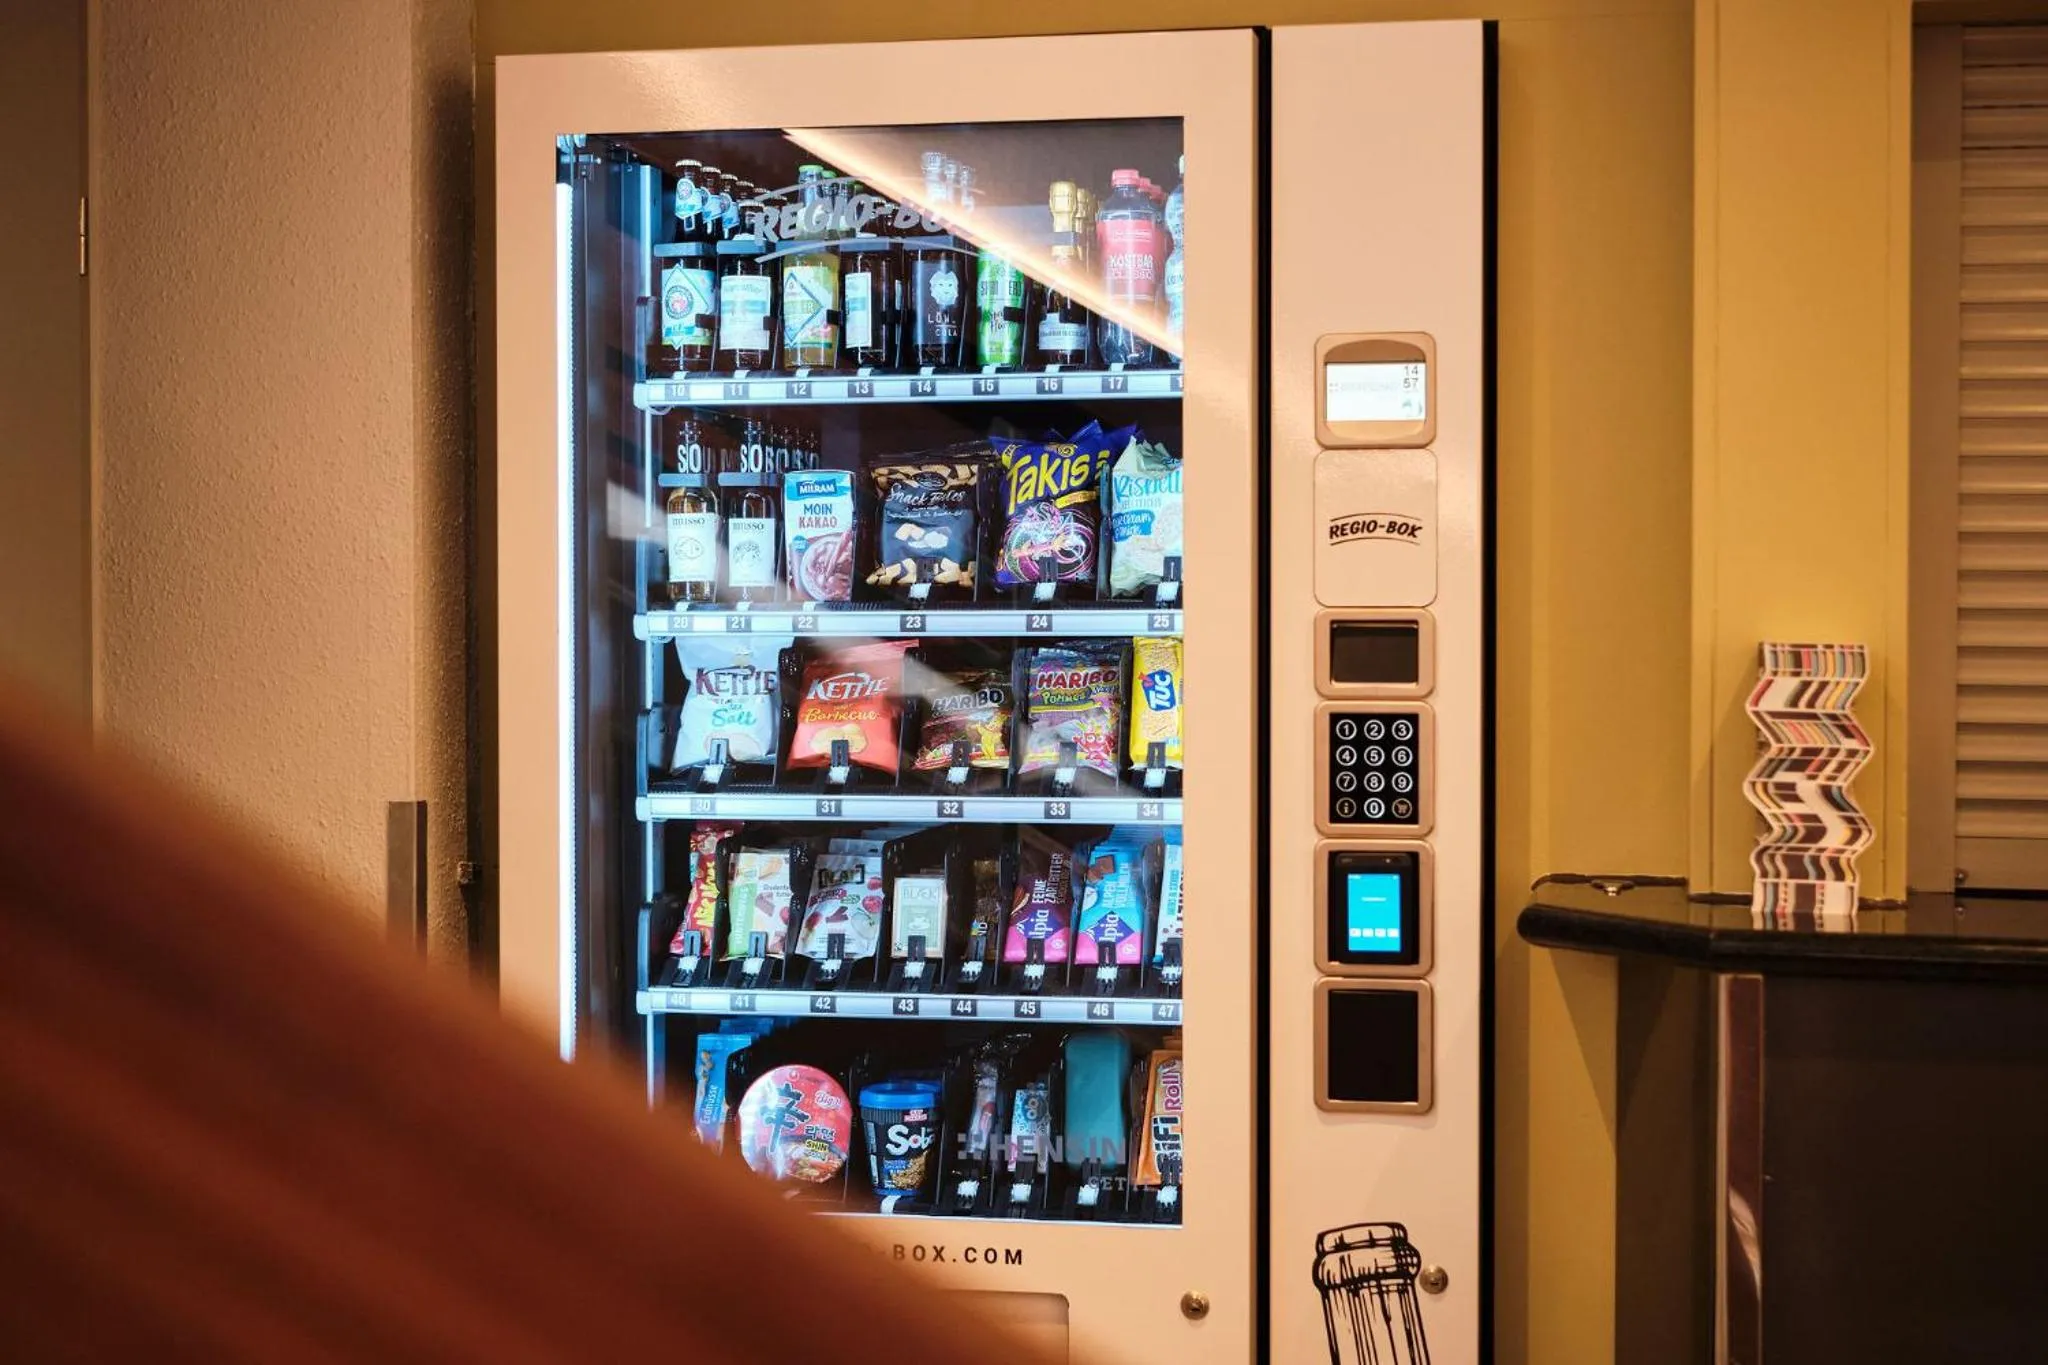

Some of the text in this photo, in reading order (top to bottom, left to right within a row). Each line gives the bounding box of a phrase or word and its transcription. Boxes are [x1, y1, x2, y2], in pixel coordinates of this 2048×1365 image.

[792, 383, 806, 395] 12
[855, 382, 869, 394] 13
[917, 381, 931, 392] 14
[979, 380, 994, 391] 15
[1042, 379, 1058, 391] 16
[1108, 378, 1123, 389] 17
[1177, 377, 1183, 389] 1
[671, 385, 685, 397] 10
[730, 384, 743, 396] 11
[799, 483, 835, 494] MILRAM
[1007, 453, 1090, 515] Takis
[886, 482, 928, 506] Snack
[803, 503, 833, 515] MOIN
[799, 516, 838, 529] KAKAO
[1329, 520, 1423, 539] REGIO-BOX
[674, 616, 688, 628] 20
[731, 616, 745, 628] 21
[798, 615, 813, 627] 22
[906, 616, 922, 628] 23
[1032, 616, 1048, 628] 24
[1153, 616, 1169, 628] 25
[1036, 668, 1118, 690] HARIBO
[806, 672, 890, 701] KETTLE
[1149, 674, 1172, 709] TUC
[932, 687, 1005, 713] HARIBO
[712, 707, 757, 727] Salt
[805, 707, 878, 723] Barbecue
[1343, 724, 1350, 736] 1
[1369, 724, 1379, 736] 2
[1397, 724, 1407, 736] 3
[1341, 750, 1351, 762] 4
[1370, 750, 1379, 762] 5
[1397, 750, 1407, 762] 6
[1342, 776, 1351, 788] 7
[1370, 776, 1379, 788] 8
[1397, 776, 1407, 788] 9
[822, 801, 836, 813] 31
[943, 802, 958, 814] 32
[1050, 803, 1066, 815] 33
[1142, 804, 1158, 816] 34
[1370, 802, 1379, 814] 0
[1032, 879, 1047, 904] FEINE
[1099, 914, 1124, 942] lpia
[735, 996, 750, 1008] 41
[815, 998, 831, 1010] 42
[899, 1000, 914, 1012] 43
[956, 1001, 972, 1013] 44
[1020, 1003, 1036, 1014] 45
[1093, 1004, 1109, 1016] 46
[1158, 1006, 1174, 1017] 47
[1162, 1073, 1184, 1111] Roll
[805, 1140, 830, 1153] SHIN
